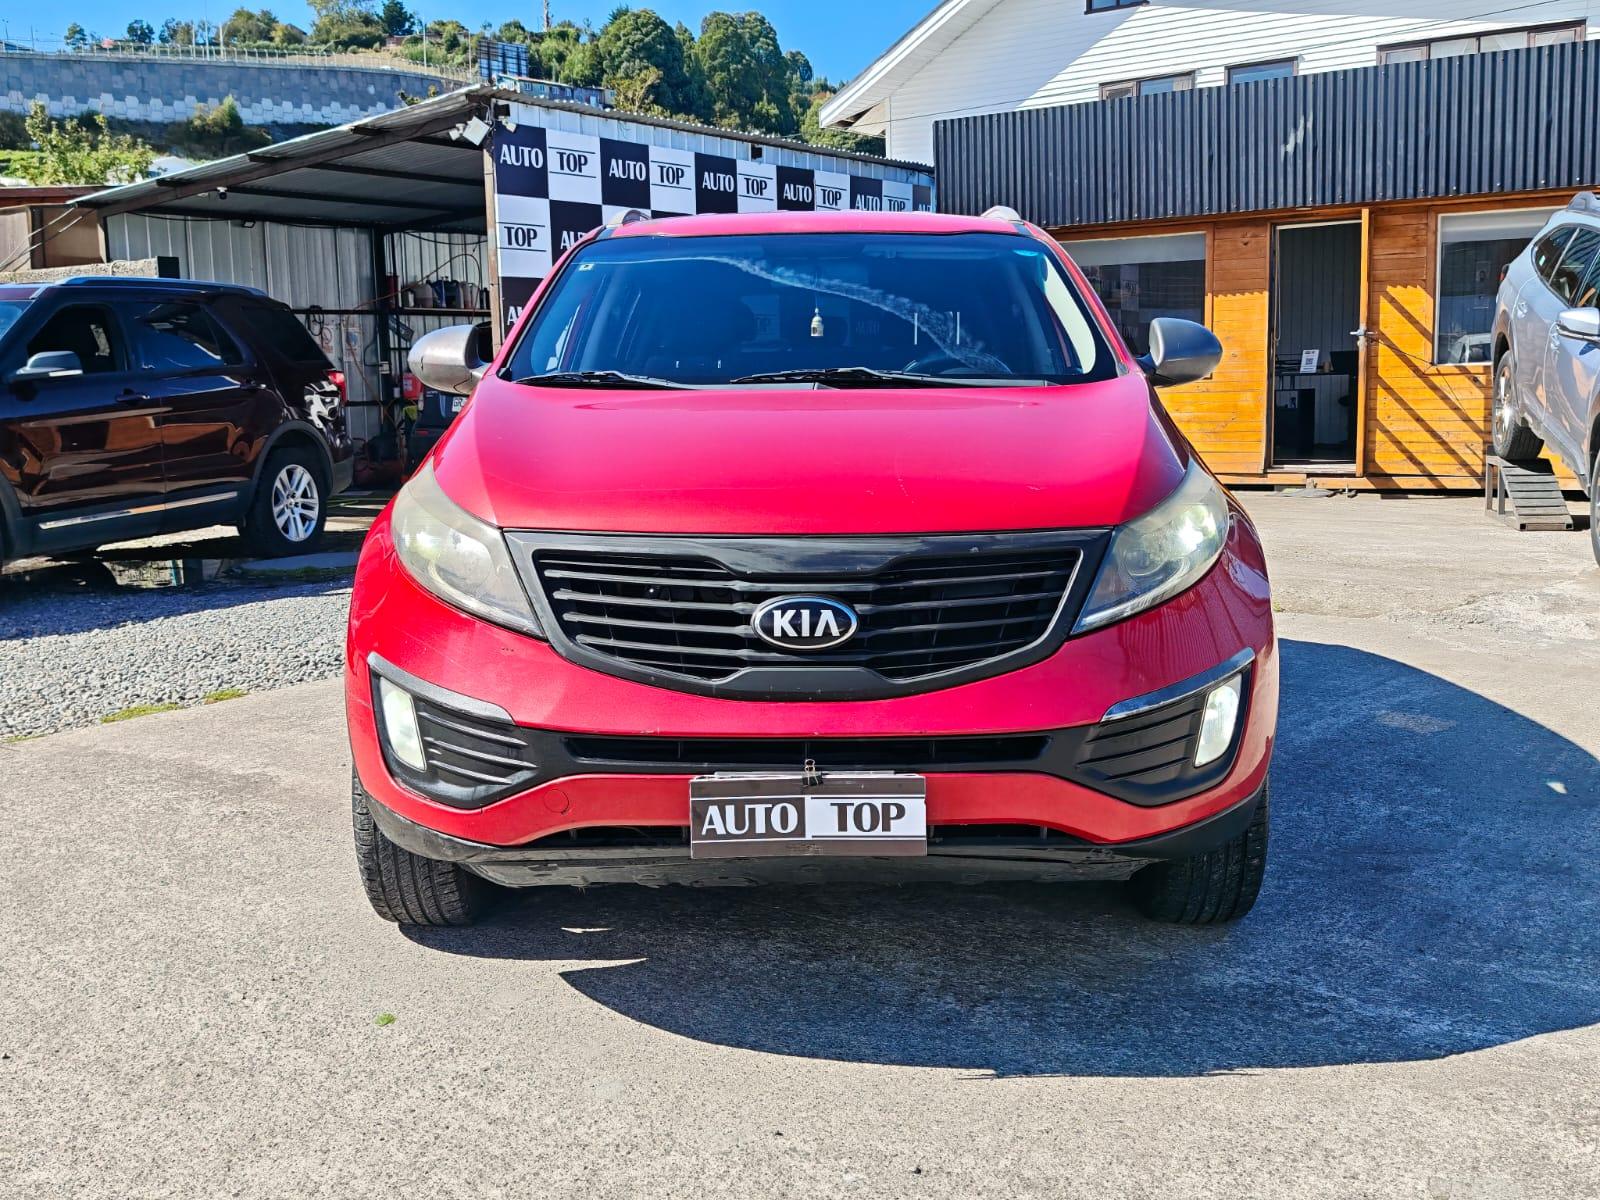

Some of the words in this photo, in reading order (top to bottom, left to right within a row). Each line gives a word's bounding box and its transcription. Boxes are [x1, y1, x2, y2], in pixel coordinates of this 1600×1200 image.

[500, 143, 544, 169] AUTO
[556, 151, 588, 173] TOP
[609, 158, 647, 181] AUTO
[657, 165, 685, 185] TOP
[702, 171, 735, 192] AUTO
[744, 177, 768, 196] TOP
[783, 183, 813, 203] AUTO
[821, 188, 842, 206] TOP
[855, 194, 880, 211] AUTO
[888, 198, 906, 211] TOP
[504, 226, 538, 248] TOP
[773, 609, 841, 637] KIA
[701, 802, 799, 835] AUTO
[830, 802, 906, 832] TOP
